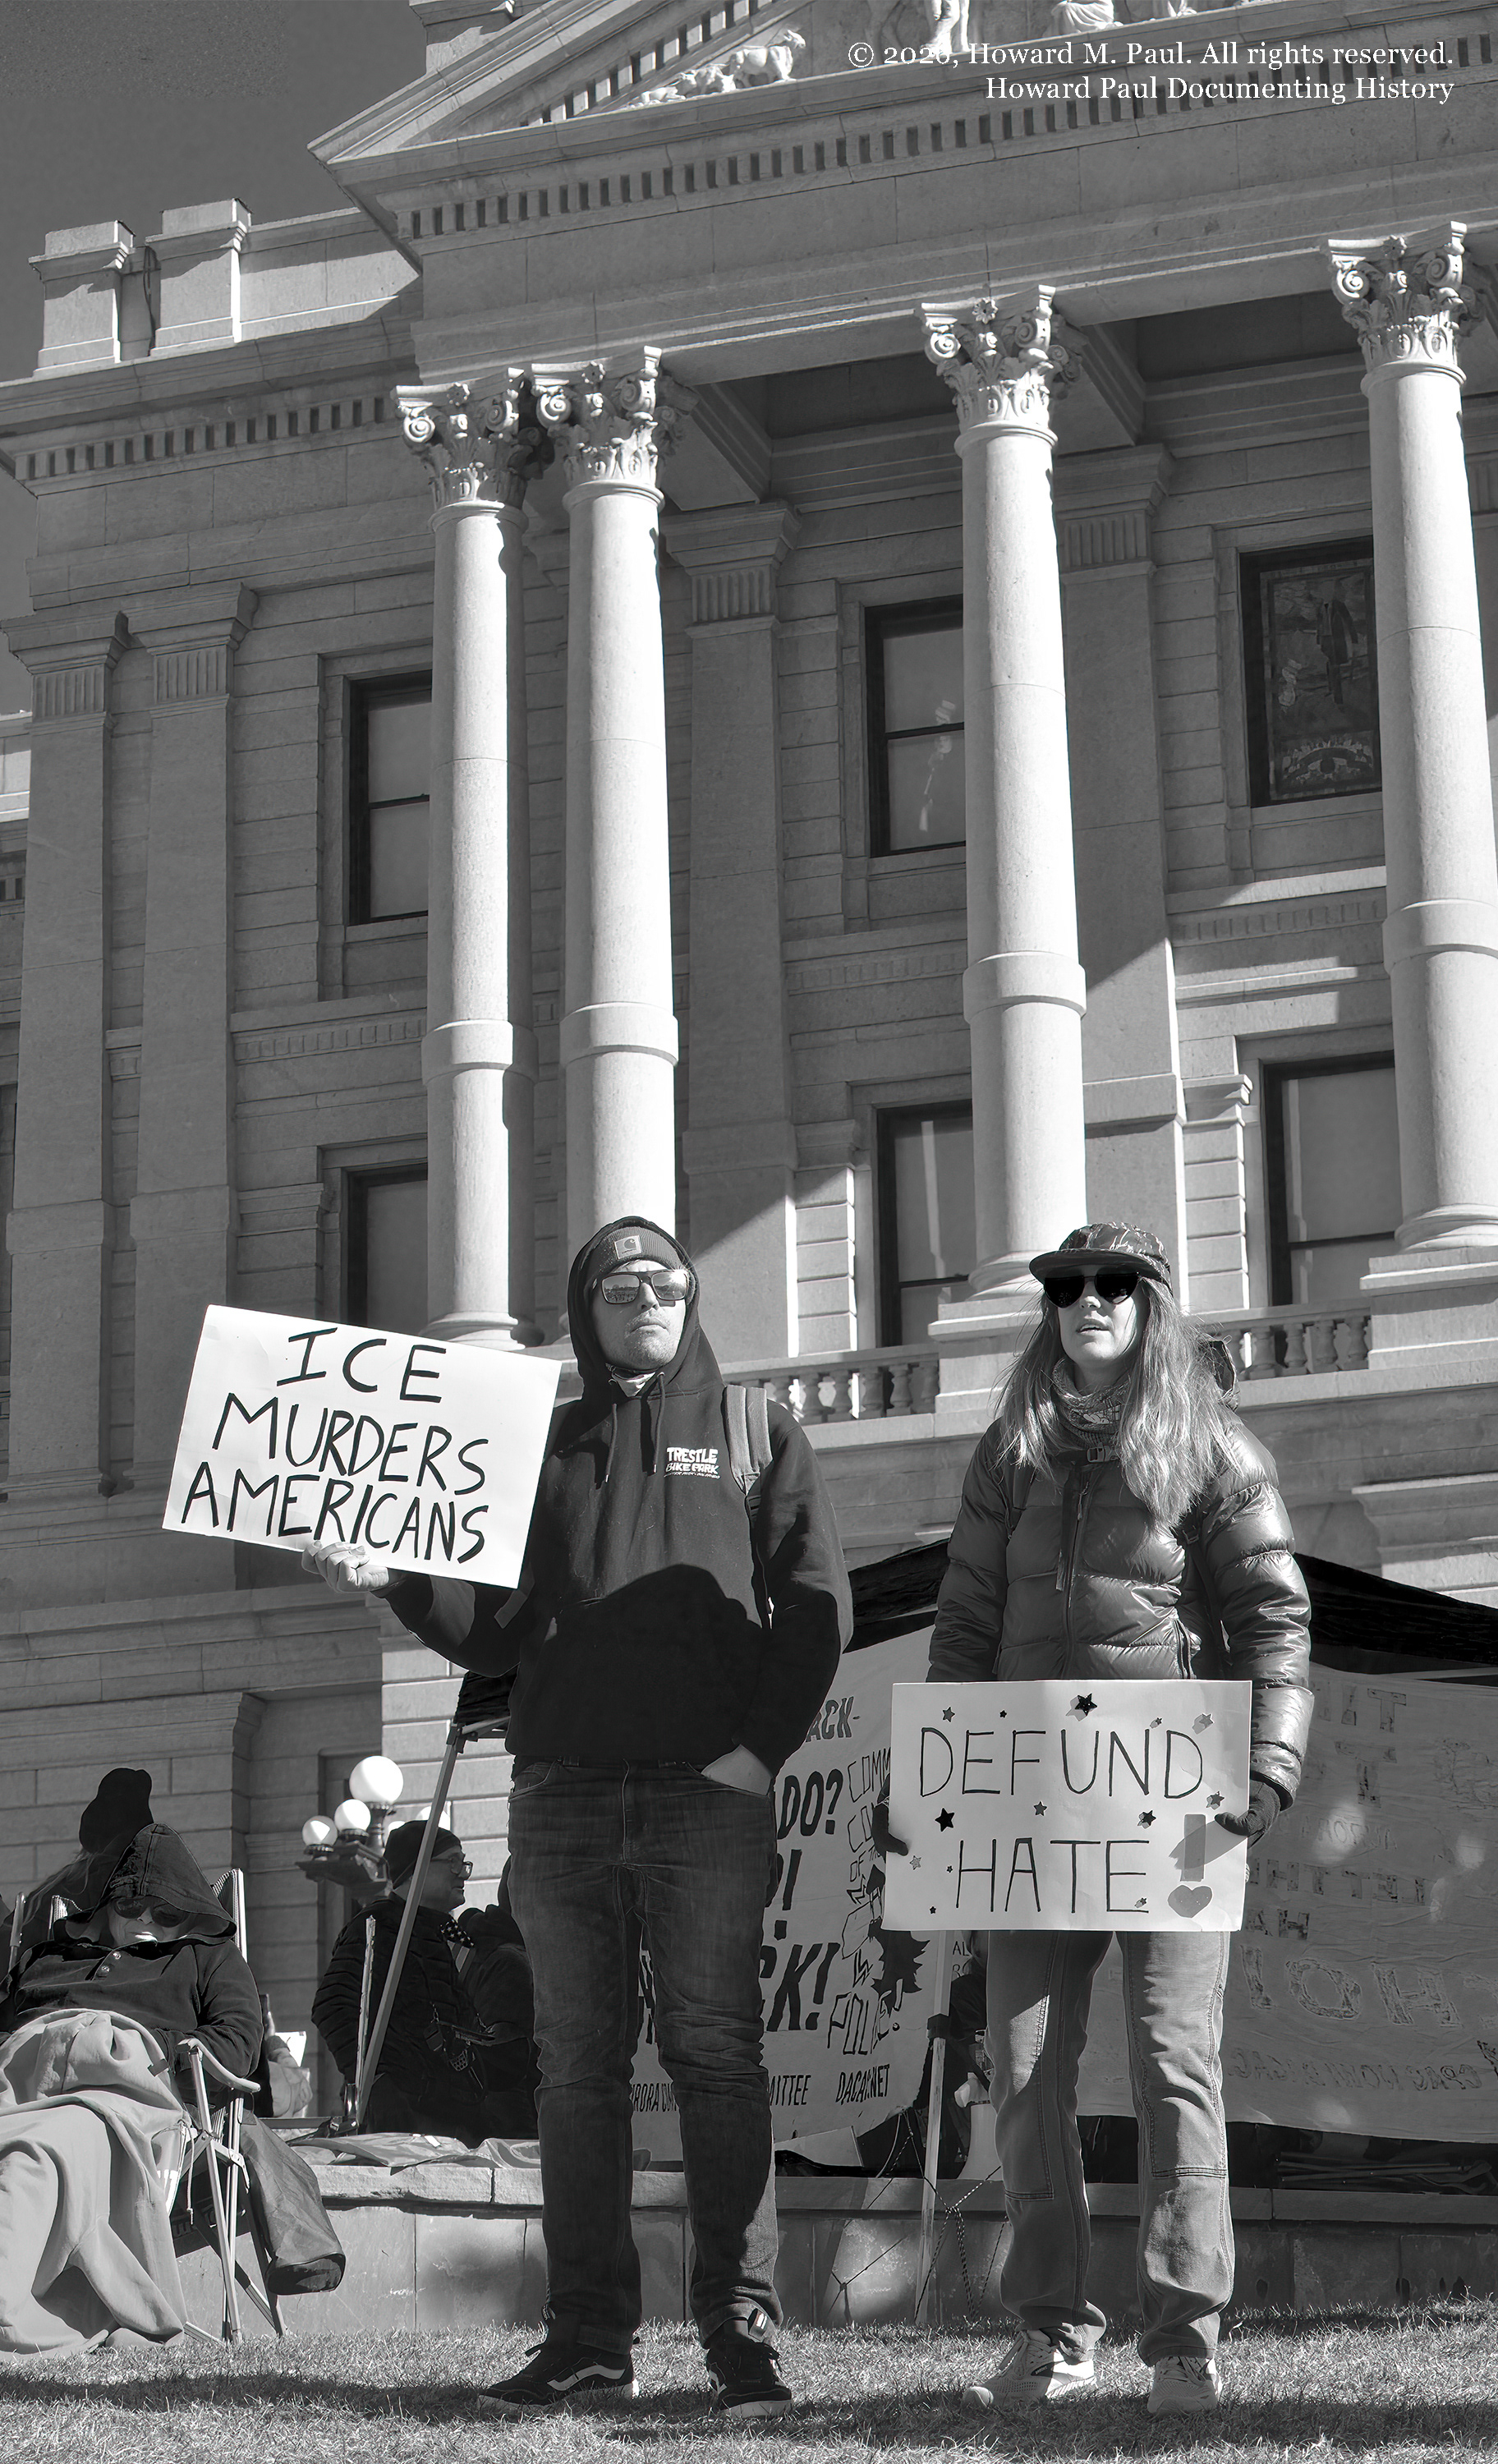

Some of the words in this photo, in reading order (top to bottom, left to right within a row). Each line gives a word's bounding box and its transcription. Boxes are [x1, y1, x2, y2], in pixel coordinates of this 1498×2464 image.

[276, 1326, 447, 1404] ICE
[212, 1392, 489, 1496] MURDERS
[665, 1462, 692, 1473] BIKE
[692, 1463, 719, 1475] PARK
[666, 1446, 719, 1464] TRESTLE
[181, 1461, 489, 1564] AMERICANS
[920, 1726, 1203, 1799] DEFUND
[777, 1768, 843, 1839] DO?
[847, 1802, 875, 1853] CO
[827, 1979, 904, 2055] POLE!
